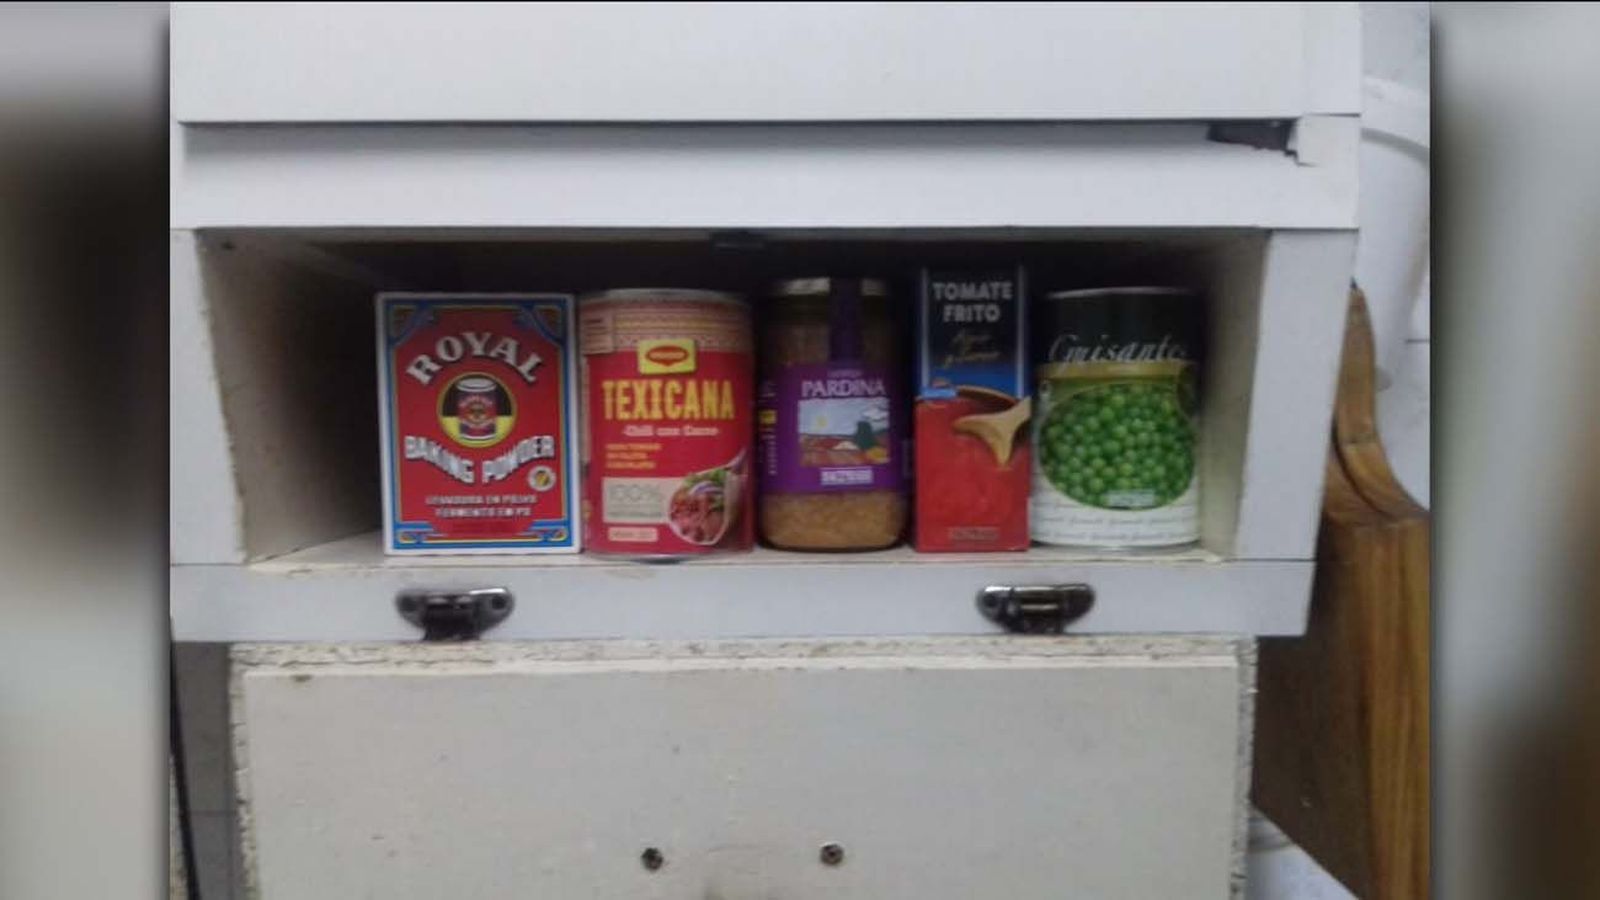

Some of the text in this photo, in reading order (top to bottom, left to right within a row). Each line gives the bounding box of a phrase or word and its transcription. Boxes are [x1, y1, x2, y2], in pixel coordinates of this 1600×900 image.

[932, 281, 1013, 300] TOMATE
[943, 303, 1001, 322] FRITO
[405, 331, 543, 385] ROYAL
[602, 379, 735, 420] TEXICANA
[801, 378, 886, 397] PARDINA
[404, 435, 555, 484] BAKING POWDER
